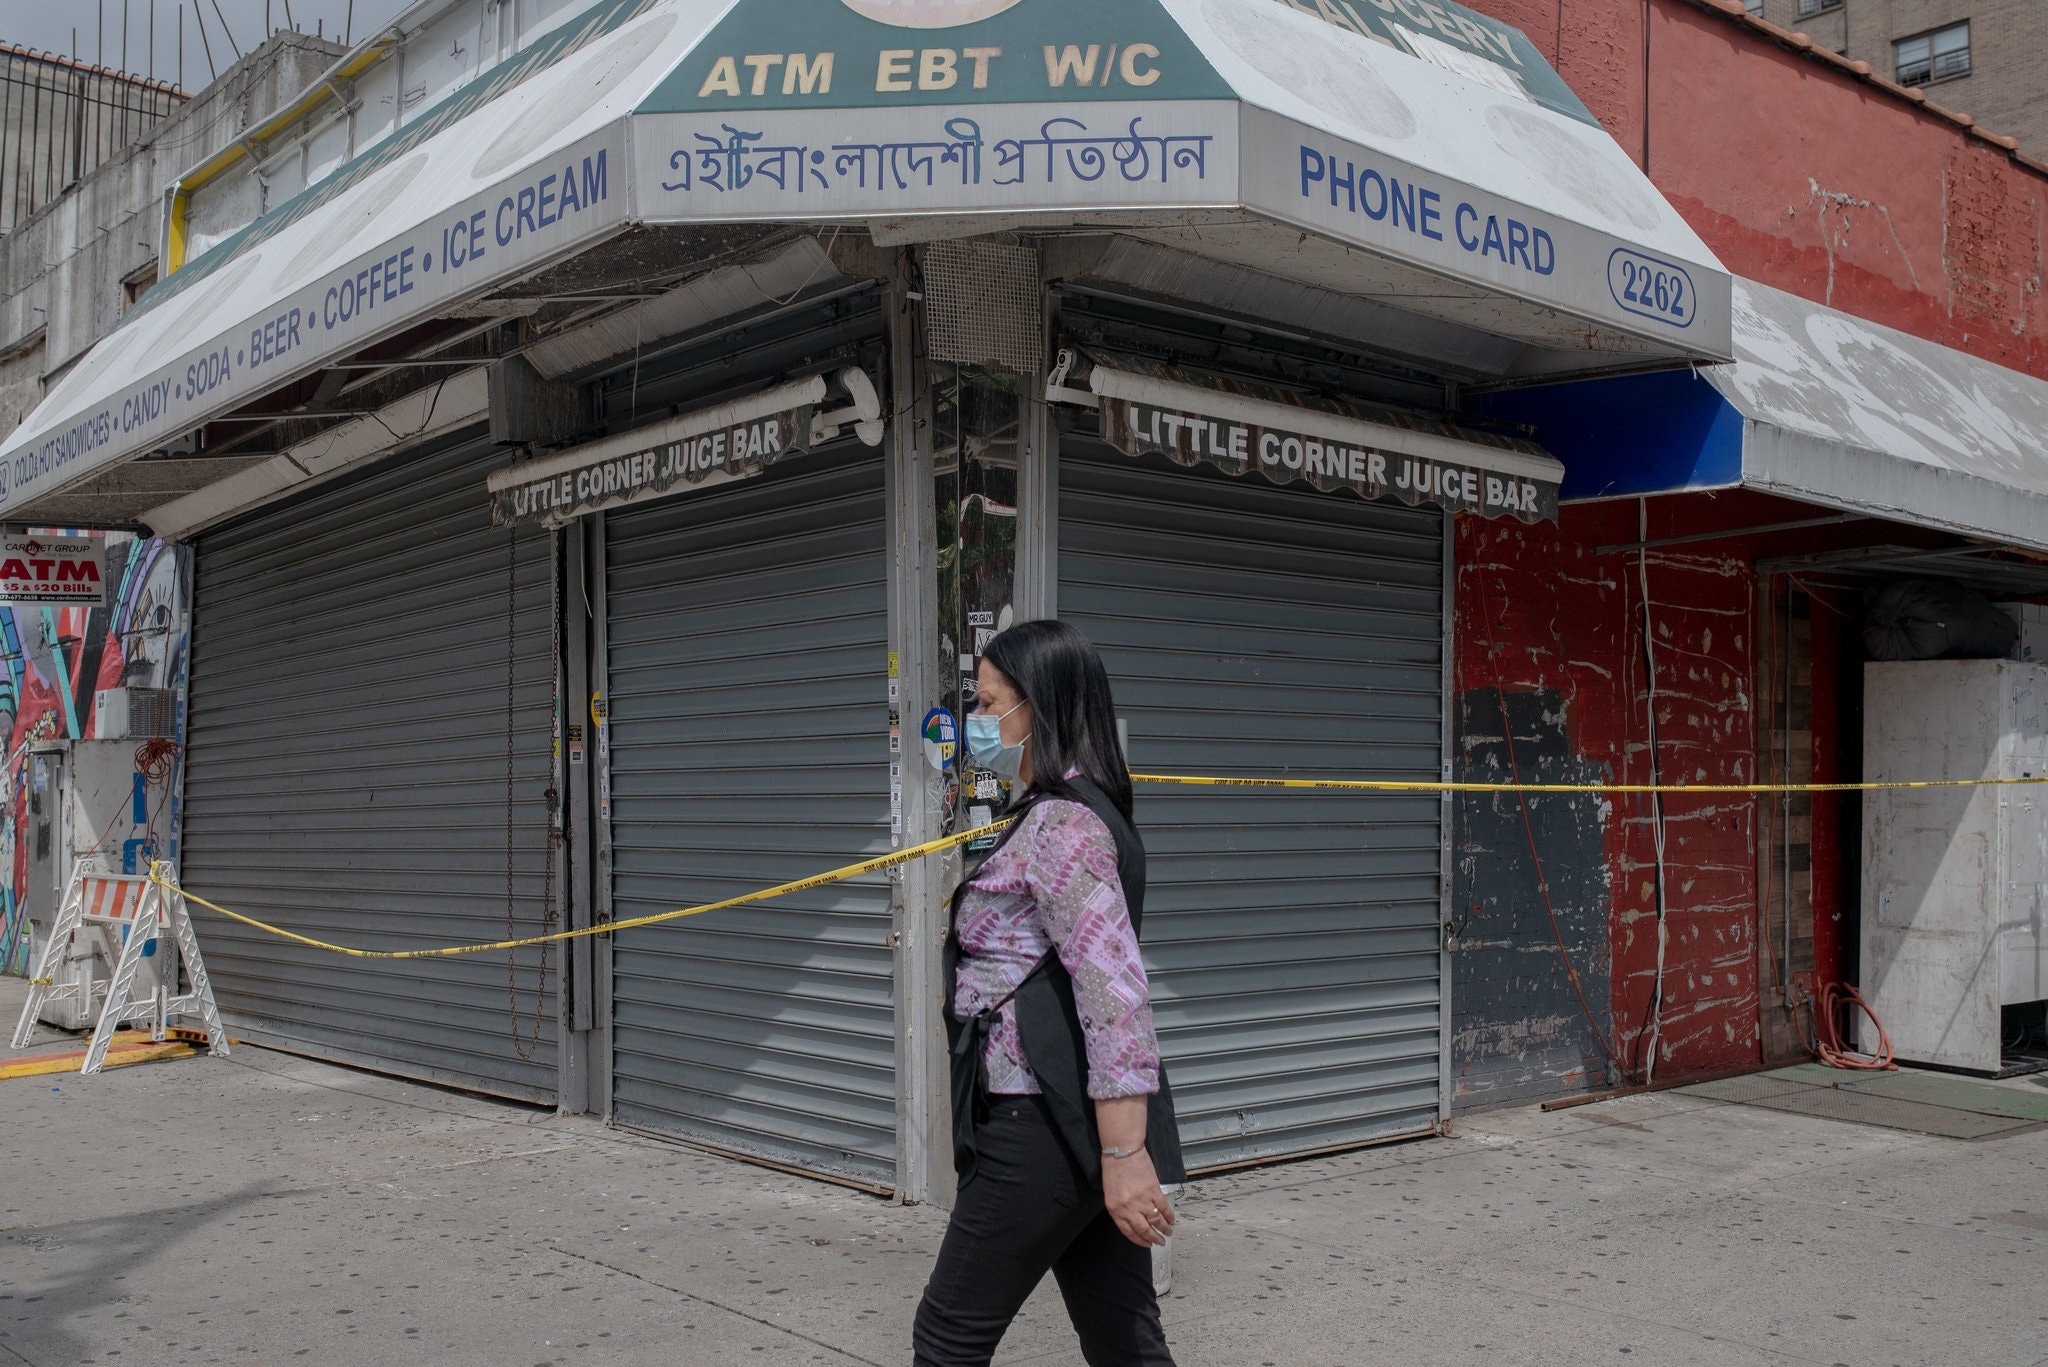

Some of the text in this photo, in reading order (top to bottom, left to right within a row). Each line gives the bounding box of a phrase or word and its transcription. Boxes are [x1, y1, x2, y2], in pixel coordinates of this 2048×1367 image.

[698, 43, 1161, 97] ATM EBT W/C
[992, 116, 1213, 185] প্রতিষ্ঠান
[1300, 145, 1555, 276] PHONE CARD
[1623, 260, 1684, 317] 2262
[14, 452, 34, 488] COLD
[40, 439, 55, 476] HOT
[55, 410, 110, 468] SANDWICHES
[123, 377, 171, 434] CANDY
[186, 345, 230, 398] SODA
[250, 307, 301, 369] BEER
[324, 246, 415, 330] COFFEE
[443, 210, 486, 274] ICE
[495, 148, 608, 247] CREAM
[512, 420, 781, 516] LITTLE CORNER JUICE BAR
[1129, 407, 1539, 513] LITTLE CORNER JUICE BAR
[0, 558, 101, 582] ATM
[54, 544, 90, 552] GROUP
[3, 583, 93, 592] $5 & $20 Bills
[940, 726, 955, 740] YORK
